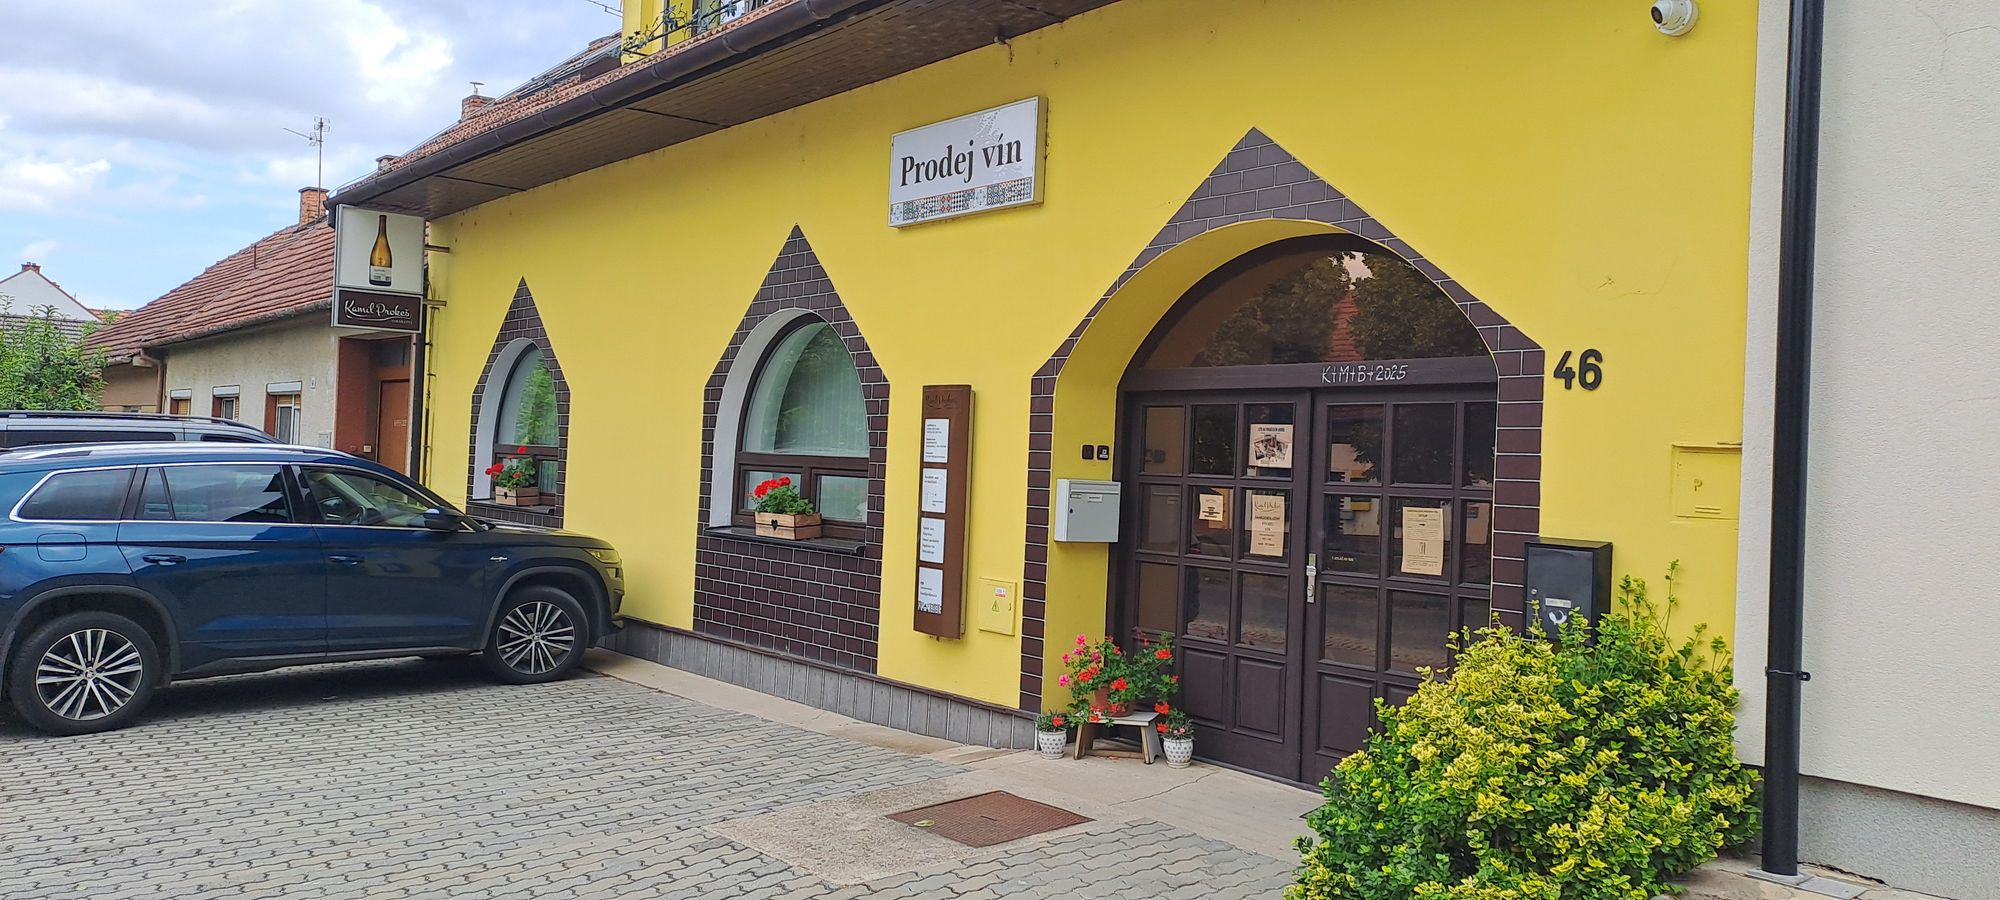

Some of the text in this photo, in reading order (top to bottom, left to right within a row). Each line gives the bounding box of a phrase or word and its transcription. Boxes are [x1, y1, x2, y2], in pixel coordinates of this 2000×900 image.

[900, 133, 1023, 187] Prodej vín
[344, 299, 410, 317] Kamil Prokeš
[1553, 348, 1603, 391] 46
